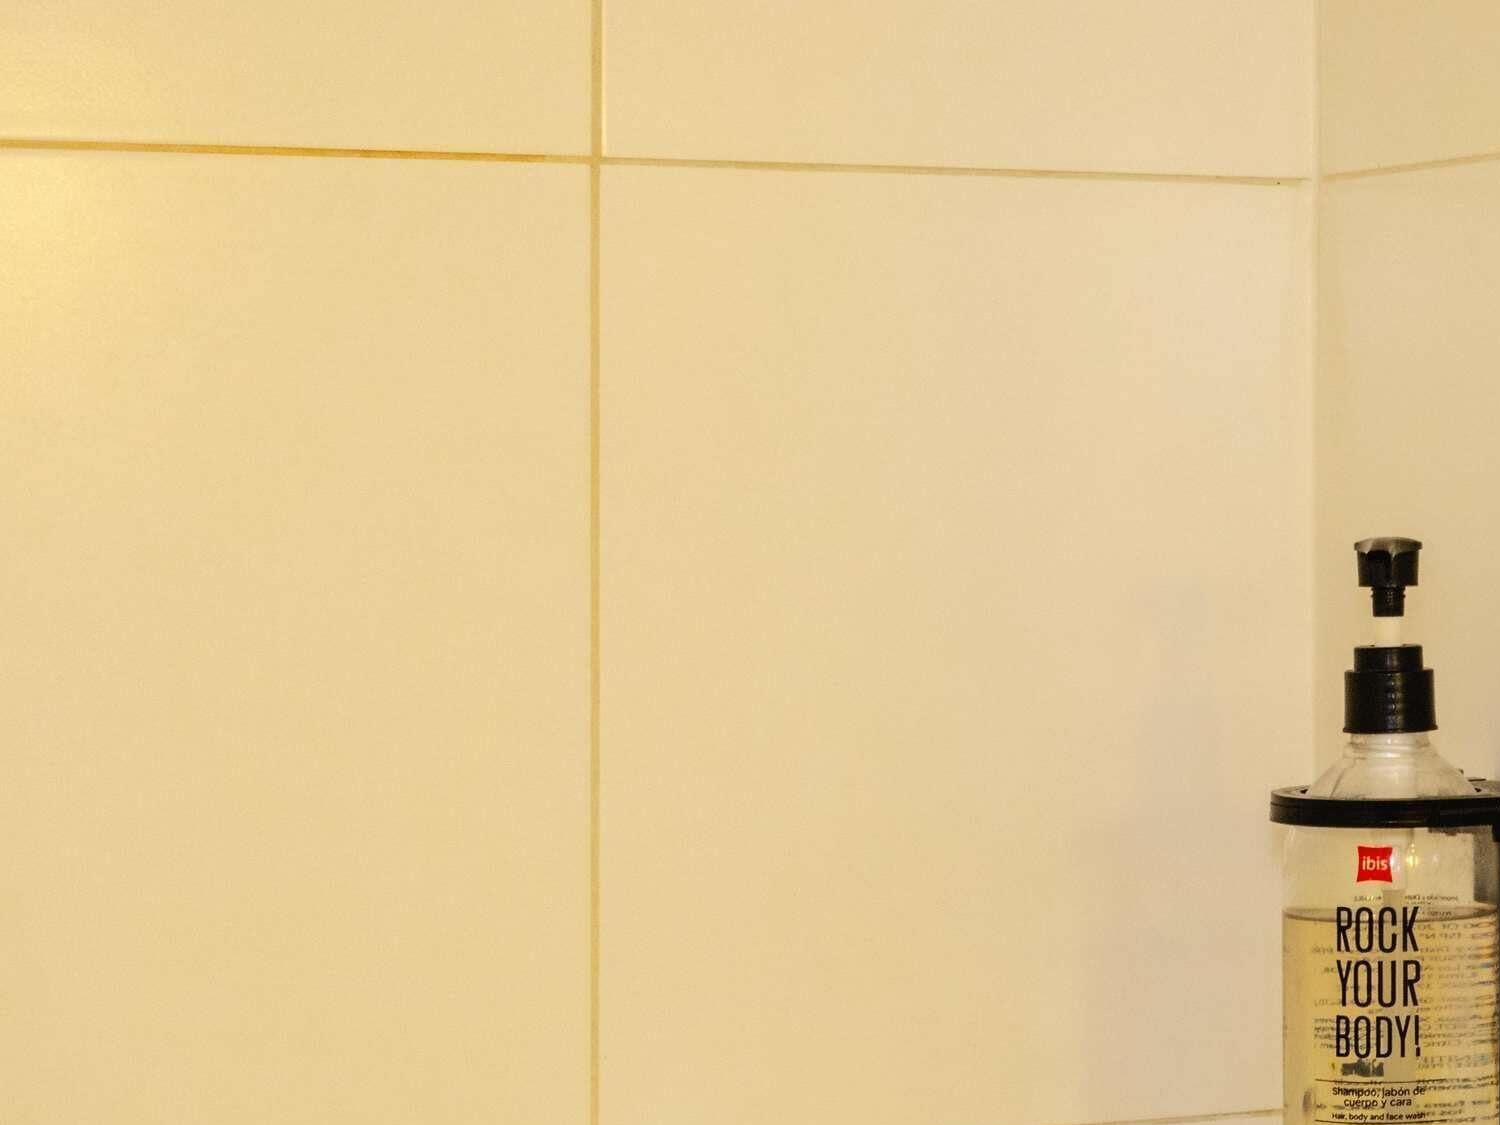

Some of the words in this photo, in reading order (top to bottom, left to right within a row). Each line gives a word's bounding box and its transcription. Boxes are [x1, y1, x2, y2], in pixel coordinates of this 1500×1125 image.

[1362, 855, 1388, 871] ibis
[1336, 905, 1420, 953] ROCK
[1336, 959, 1421, 1008] YOUR
[1335, 1014, 1421, 1058] BODY!
[1413, 1085, 1425, 1096] de
[1344, 1099, 1378, 1108] cuerpo
[1380, 1099, 1387, 1109] y
[1390, 1098, 1412, 1107] cara
[1349, 1112, 1368, 1122] body
[1386, 1112, 1403, 1120] face
[1405, 1112, 1425, 1120] wash
